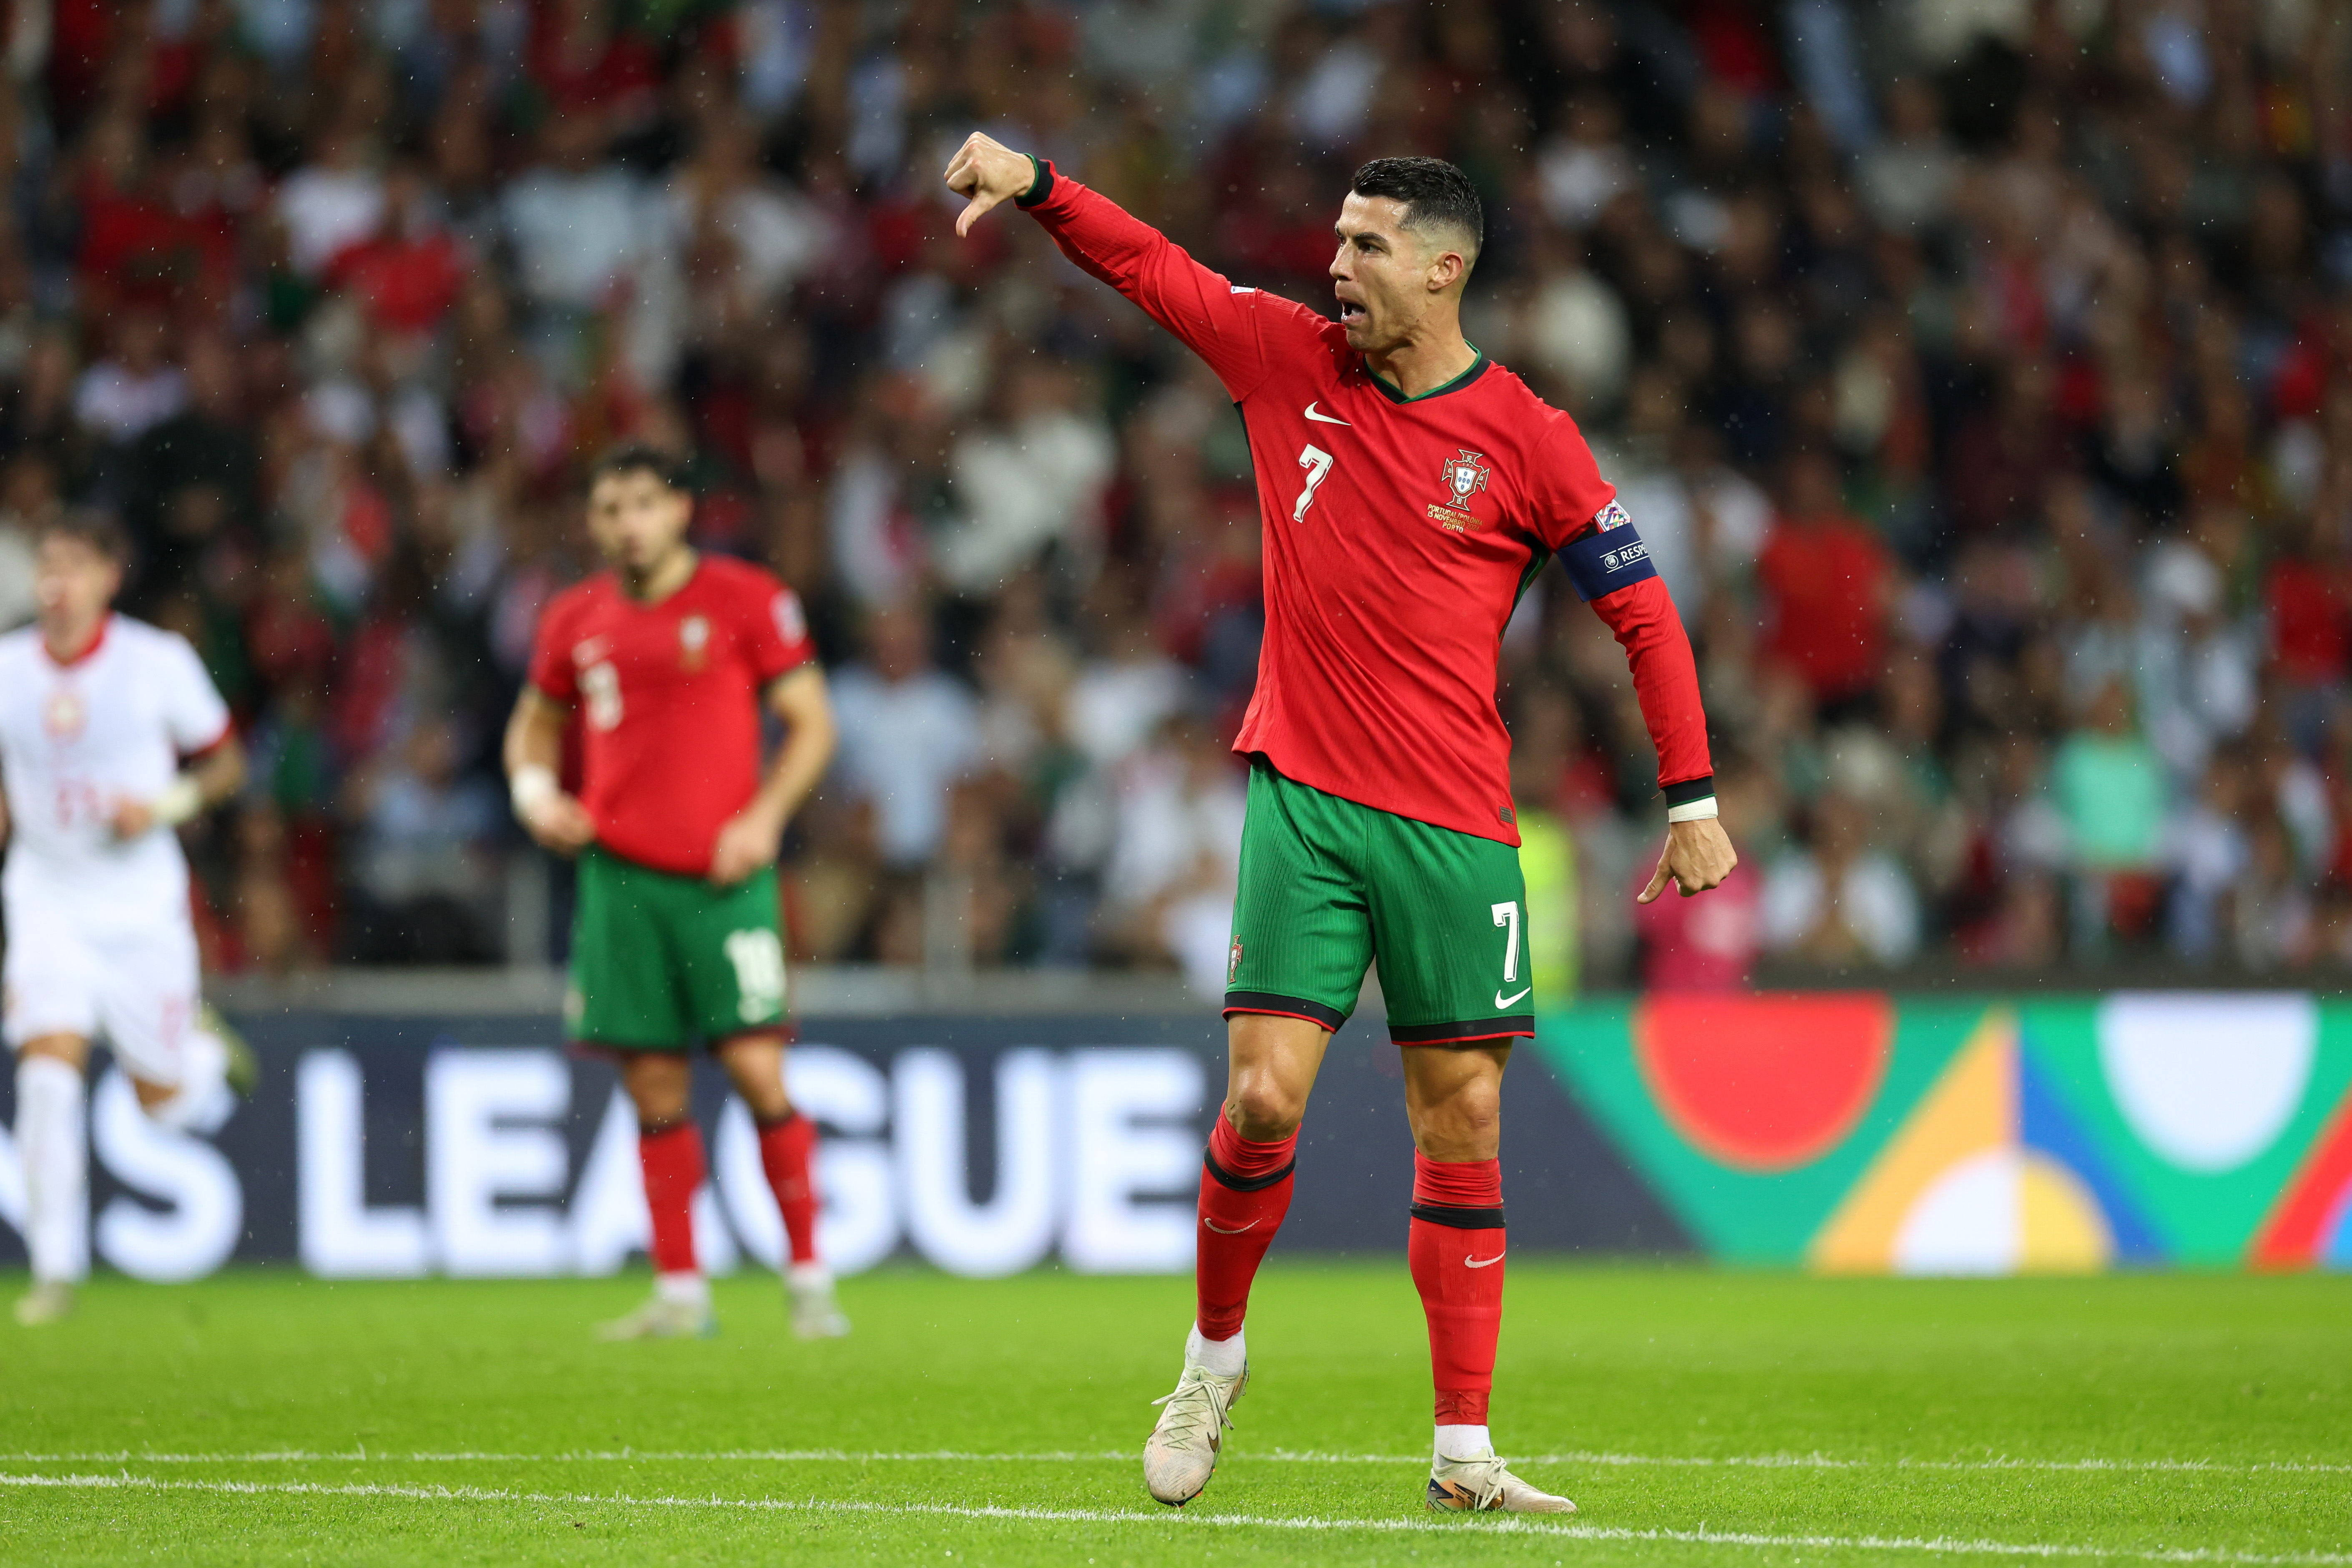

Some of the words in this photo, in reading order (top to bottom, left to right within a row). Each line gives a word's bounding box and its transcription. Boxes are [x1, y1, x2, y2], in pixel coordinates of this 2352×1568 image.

[1293, 444, 1333, 523] 7
[1434, 513, 1465, 527] NOVEMBRO
[1442, 522, 1464, 533] PORTO
[1491, 901, 1519, 982] 7
